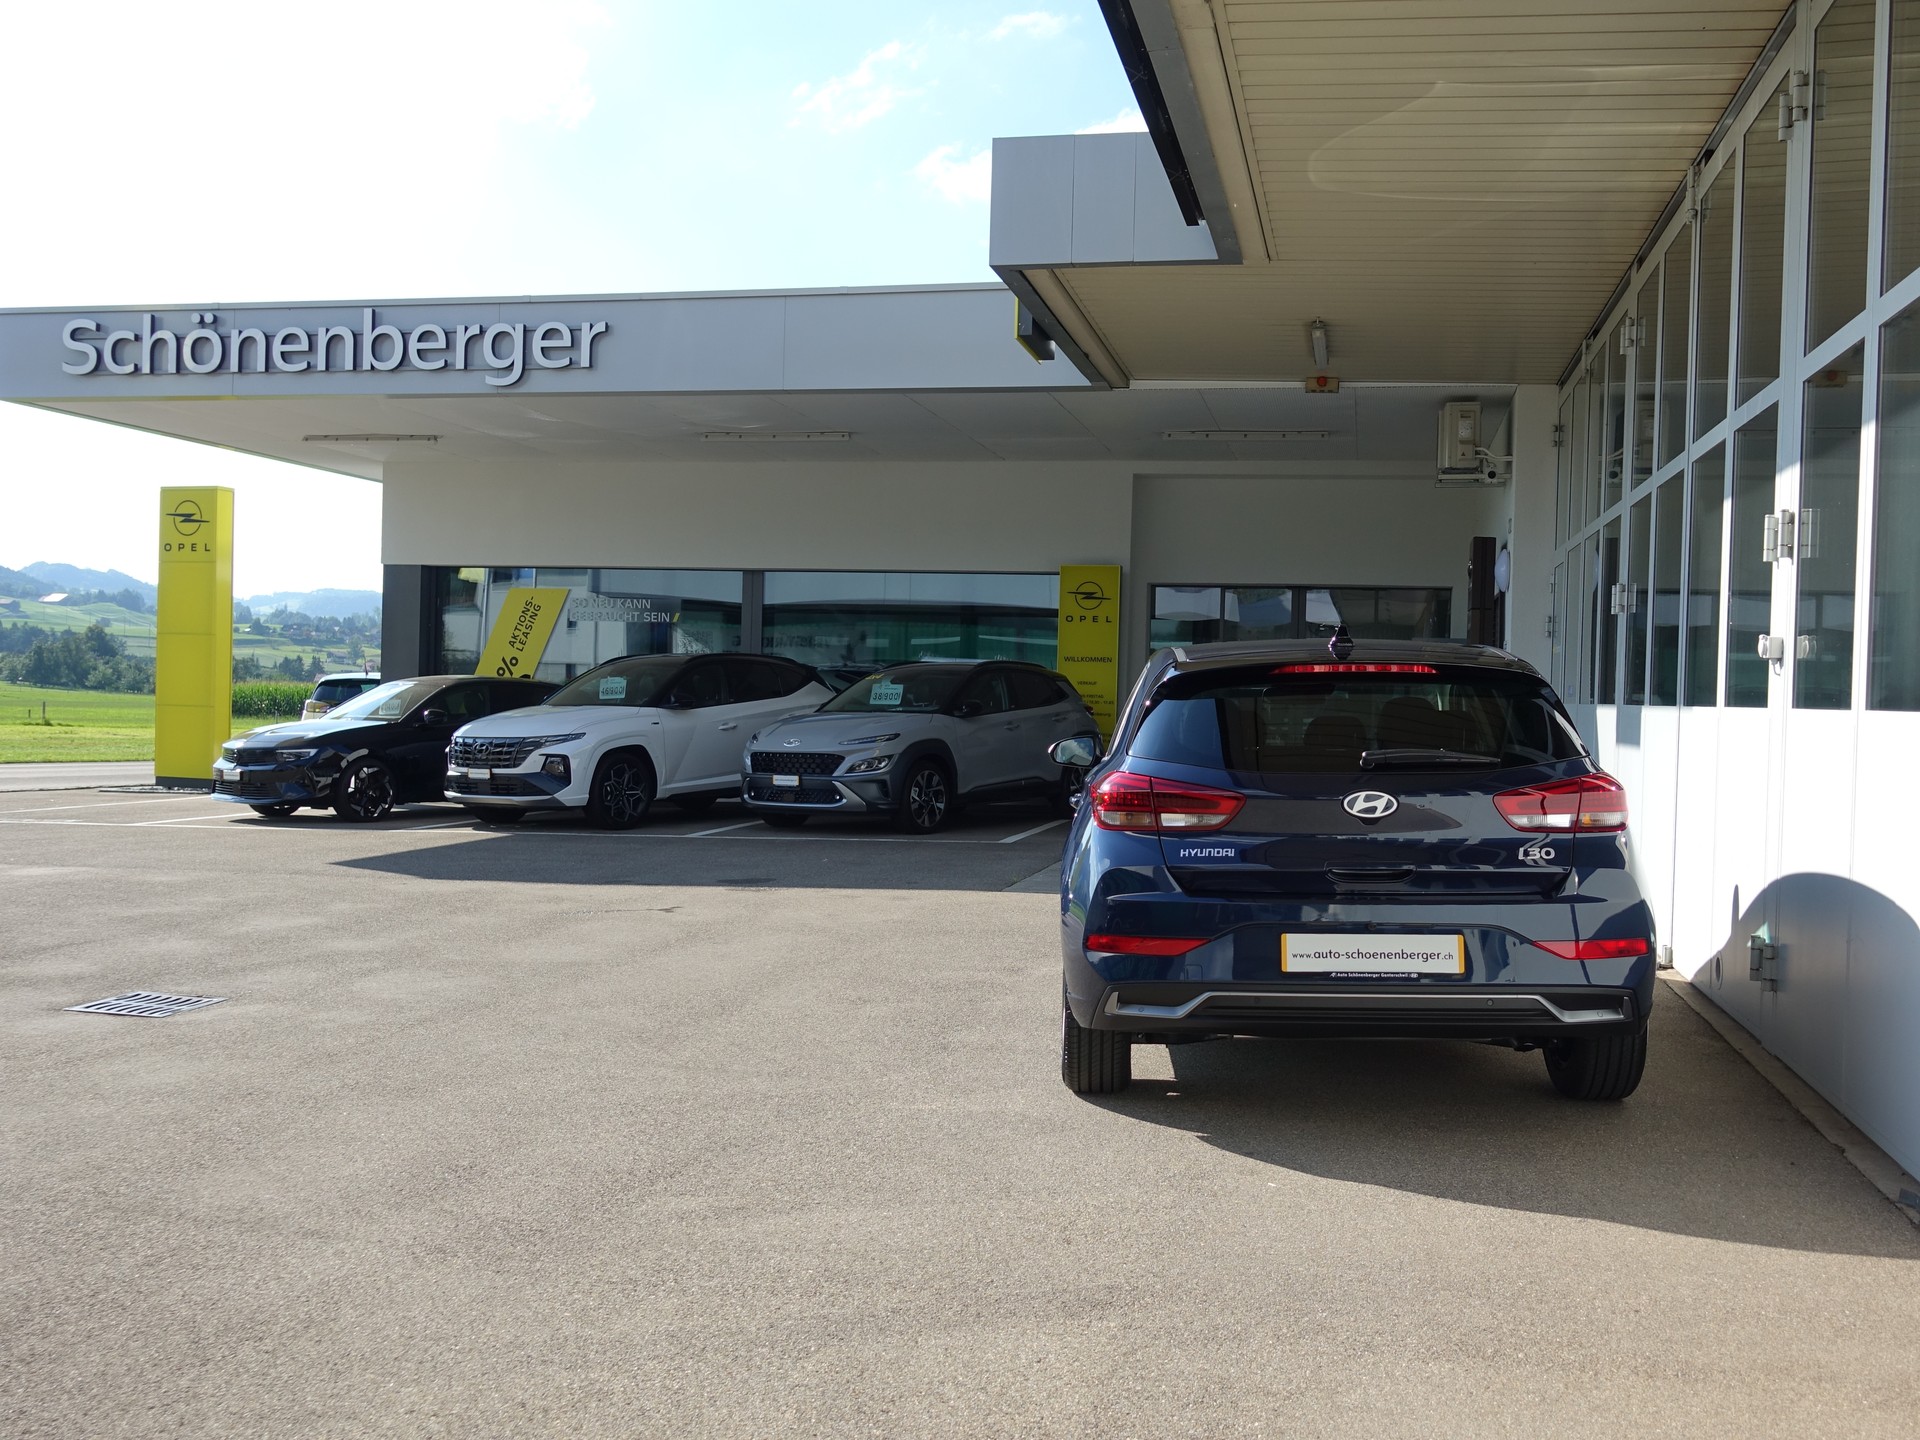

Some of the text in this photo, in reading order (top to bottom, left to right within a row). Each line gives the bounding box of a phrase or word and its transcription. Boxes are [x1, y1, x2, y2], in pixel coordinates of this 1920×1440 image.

[61, 307, 610, 388] Schönenberger
[163, 542, 211, 552] OPEL
[590, 598, 614, 609] NEU
[617, 598, 651, 609] KANN
[508, 595, 534, 649] AKTIONS-
[643, 612, 670, 623] SEIN
[1065, 615, 1113, 623] OPEL
[515, 604, 542, 652] LEASING
[1179, 848, 1235, 857] HYUNDAI
[1291, 948, 1454, 962] www.auto-schoenenberger.ch
